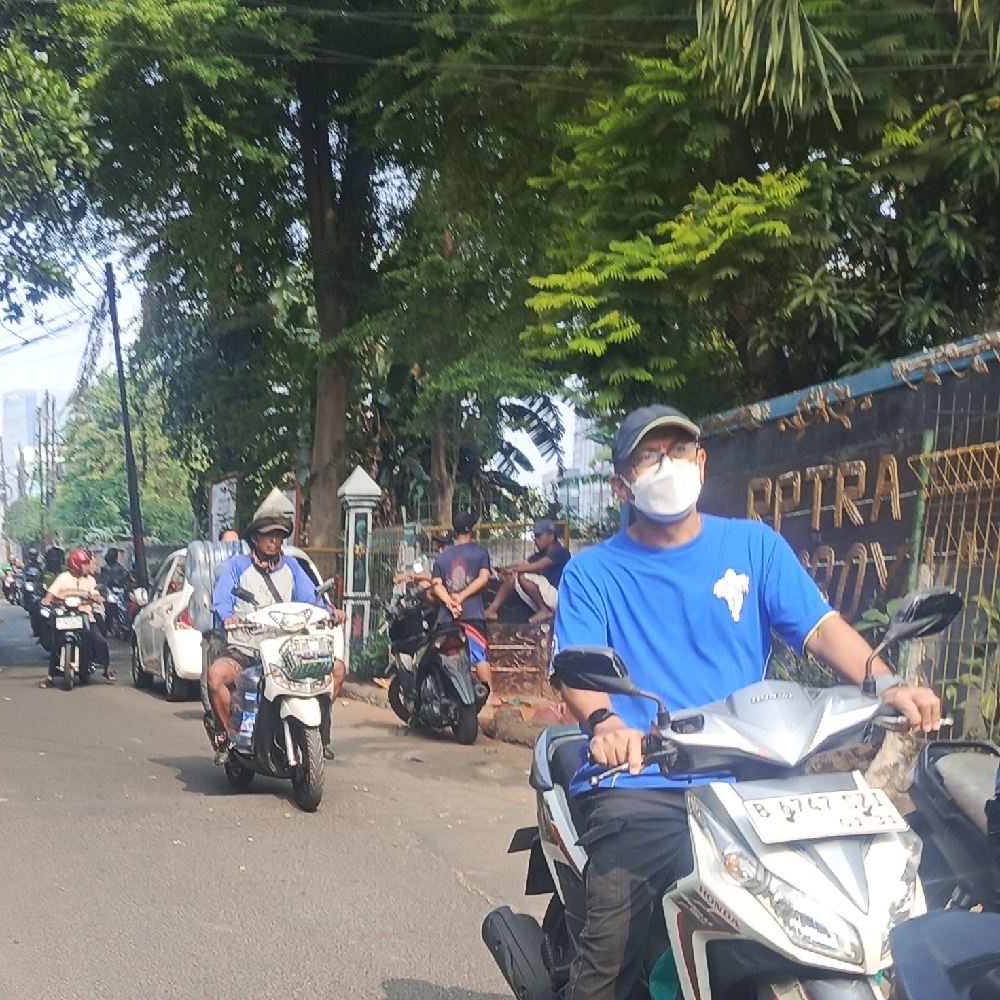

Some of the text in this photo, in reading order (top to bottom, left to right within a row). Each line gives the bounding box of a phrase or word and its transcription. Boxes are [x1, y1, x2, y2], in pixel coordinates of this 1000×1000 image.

[746, 453, 902, 533] RPTRA
[753, 803, 770, 818] B
[699, 885, 741, 930] HONDA
